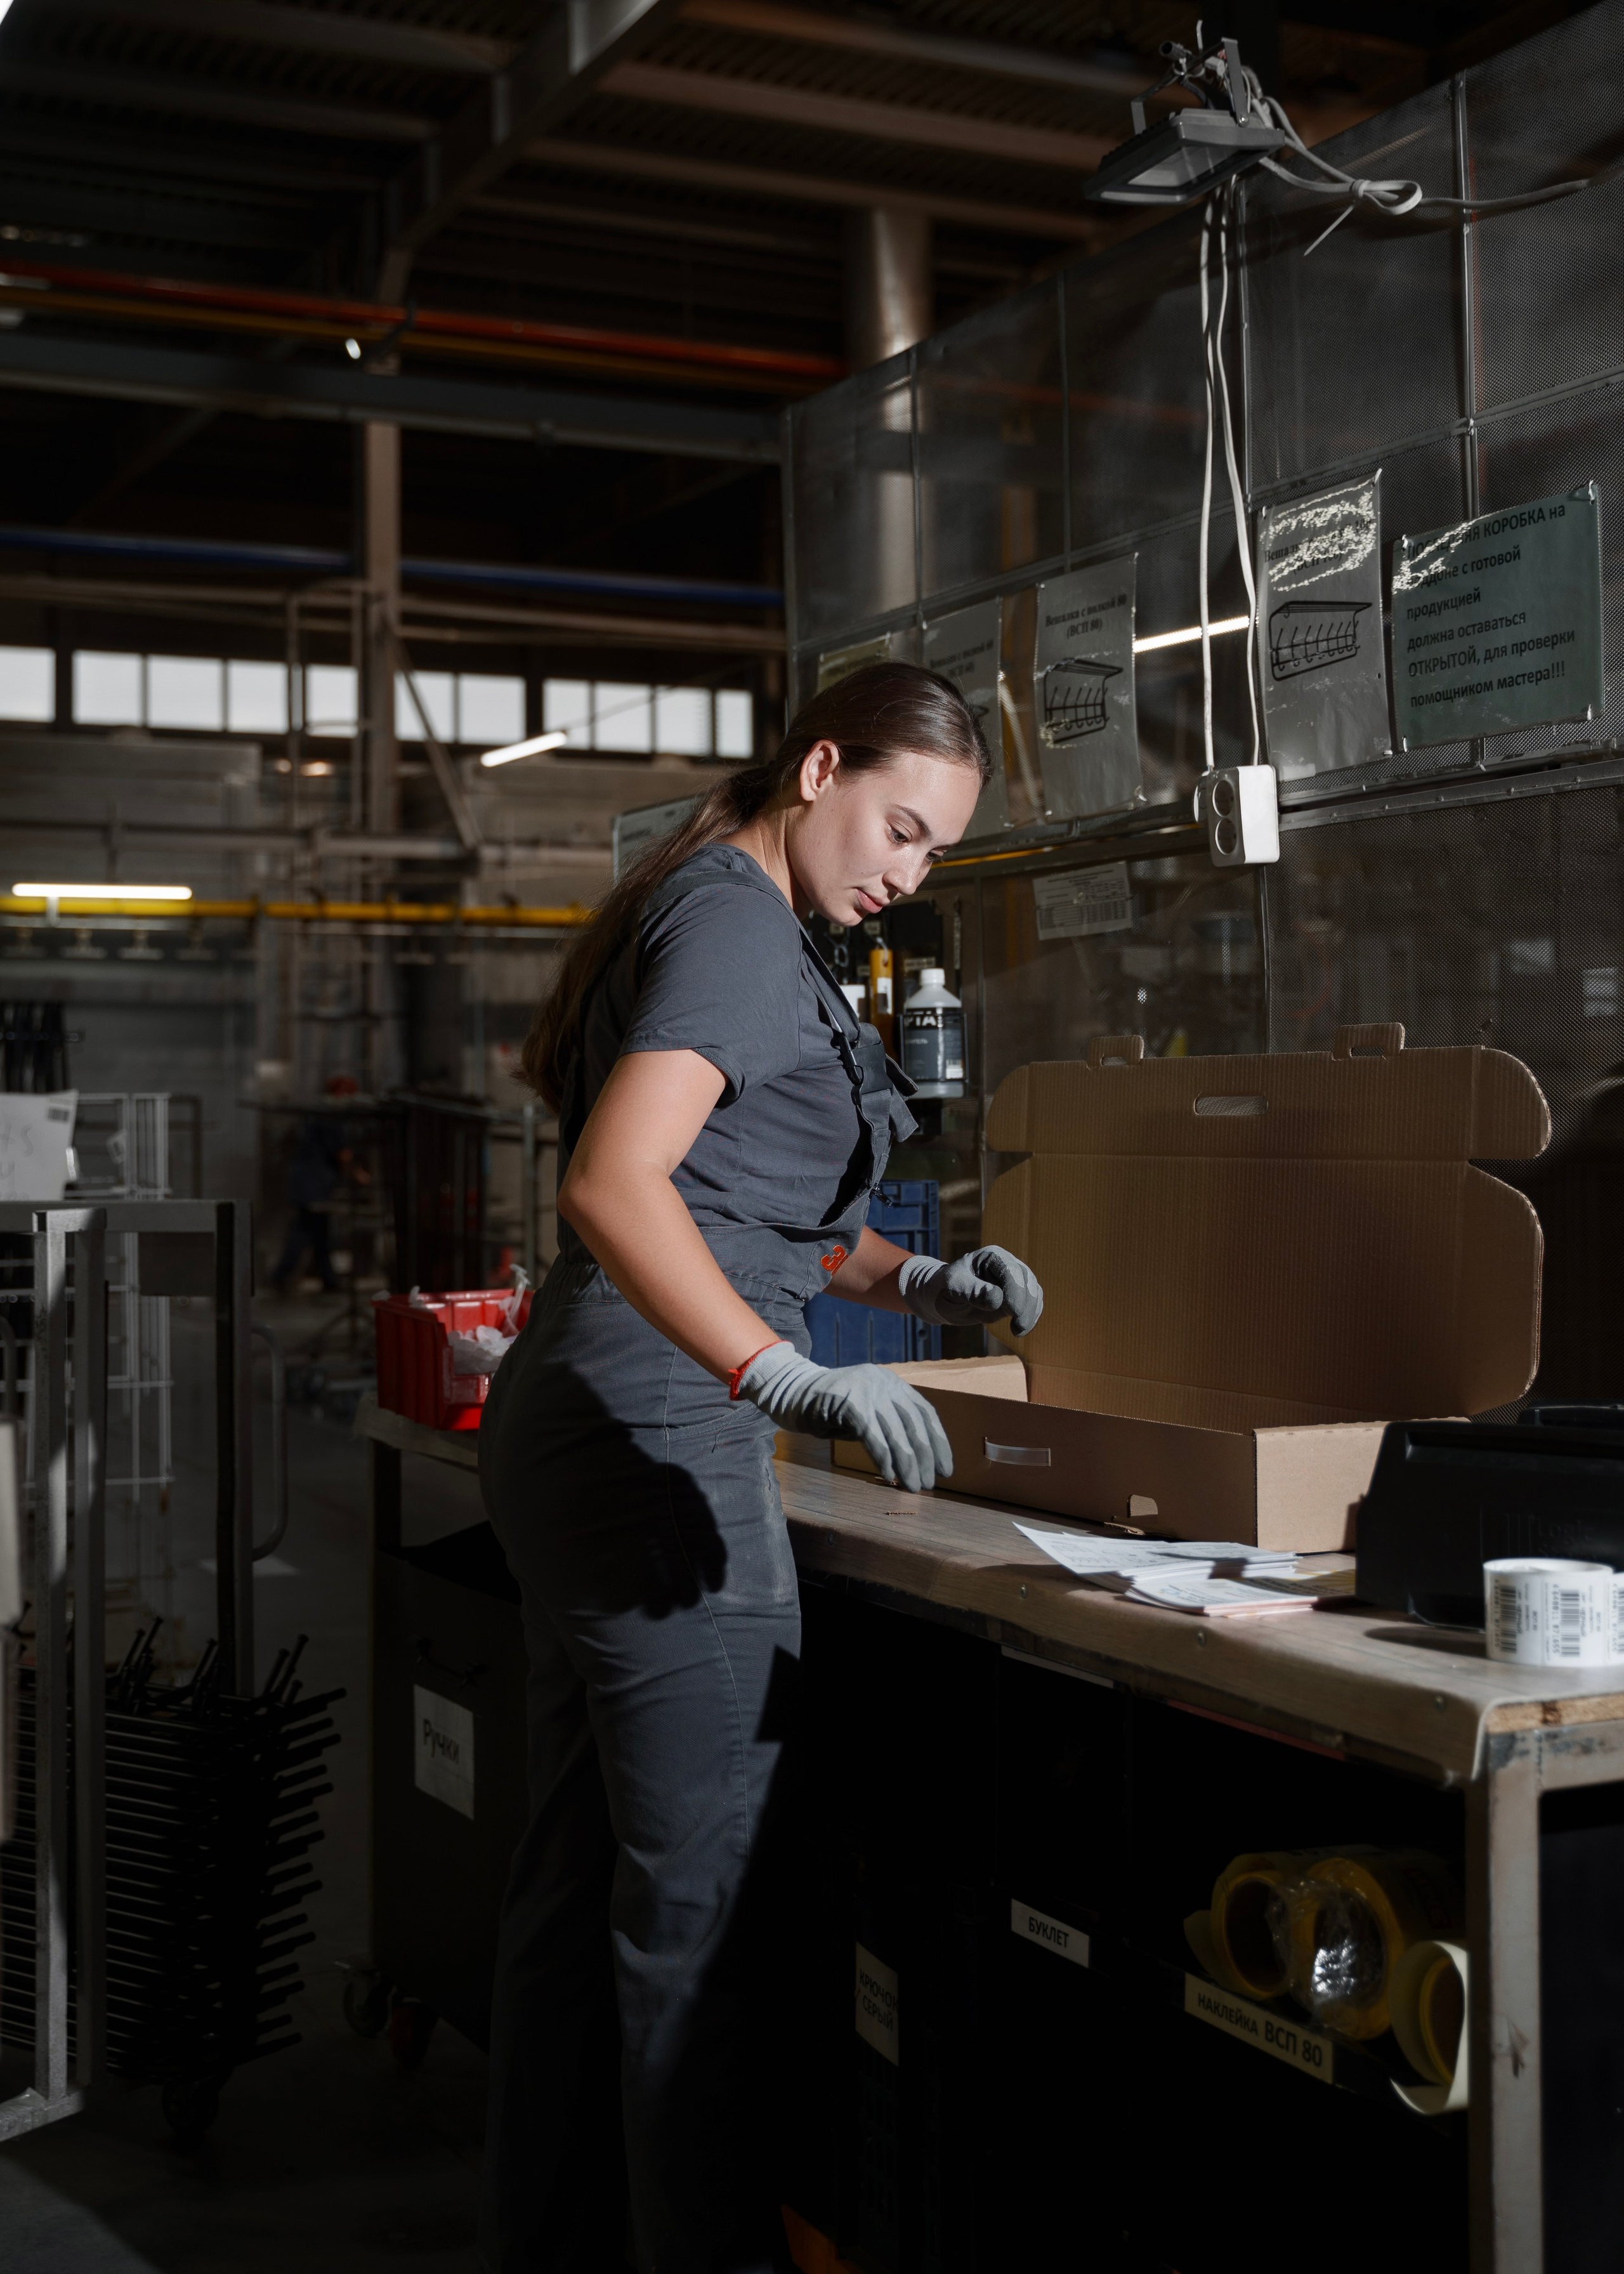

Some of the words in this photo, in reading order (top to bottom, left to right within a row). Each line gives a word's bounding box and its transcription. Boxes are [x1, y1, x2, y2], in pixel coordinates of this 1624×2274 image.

[1407, 525, 1480, 559] ПОСЕДЯЯ
[1484, 509, 1545, 539] КОРОБКА
[1549, 504, 1566, 519] на
[1462, 563, 1468, 574] с
[1471, 545, 1521, 572] готовой
[1407, 587, 1481, 622] продукцией
[1408, 629, 1454, 653] должна
[1458, 612, 1526, 637] оставаться
[1408, 645, 1480, 677] ОТКРЫТОЙ,
[1484, 646, 1507, 663] для
[1511, 630, 1575, 657] проверки
[1411, 681, 1493, 707] помощником
[1497, 660, 1565, 689] мастера!!!
[423, 1718, 459, 1765] Ручки
[1028, 1916, 1069, 1948] БУКЛЕТ
[859, 1969, 899, 2012] КРЮЧОК
[862, 1994, 894, 2032] СЕРЫЙ
[1198, 1992, 1259, 2036] НАКЛЕЙКА
[1265, 2020, 1297, 2055] ВСП
[1302, 2040, 1323, 2067] 80
